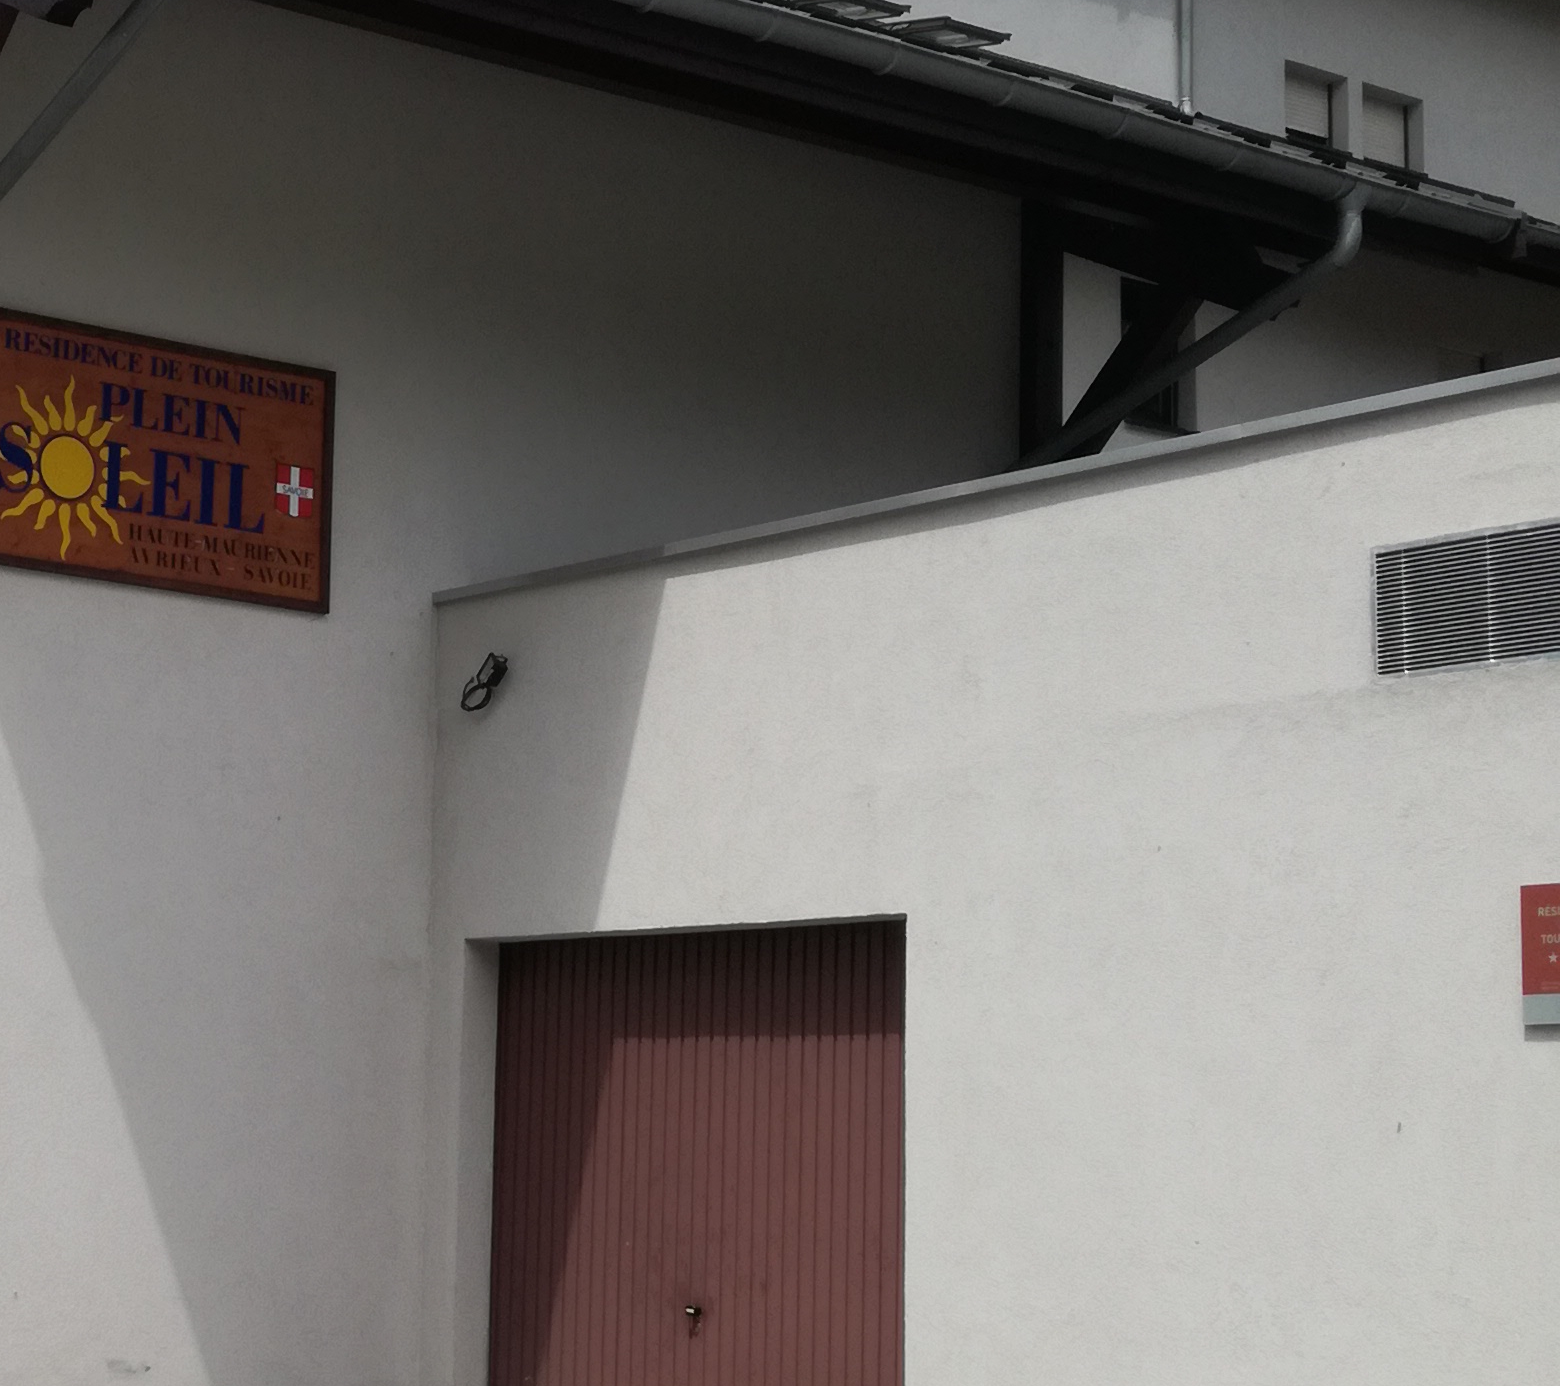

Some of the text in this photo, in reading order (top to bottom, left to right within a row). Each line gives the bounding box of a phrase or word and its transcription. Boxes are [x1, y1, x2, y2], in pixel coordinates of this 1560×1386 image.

[4, 327, 315, 406] RESIDENCE DE TOURISME
[98, 381, 246, 446] PLEIN
[243, 564, 313, 591] SAVOIE
